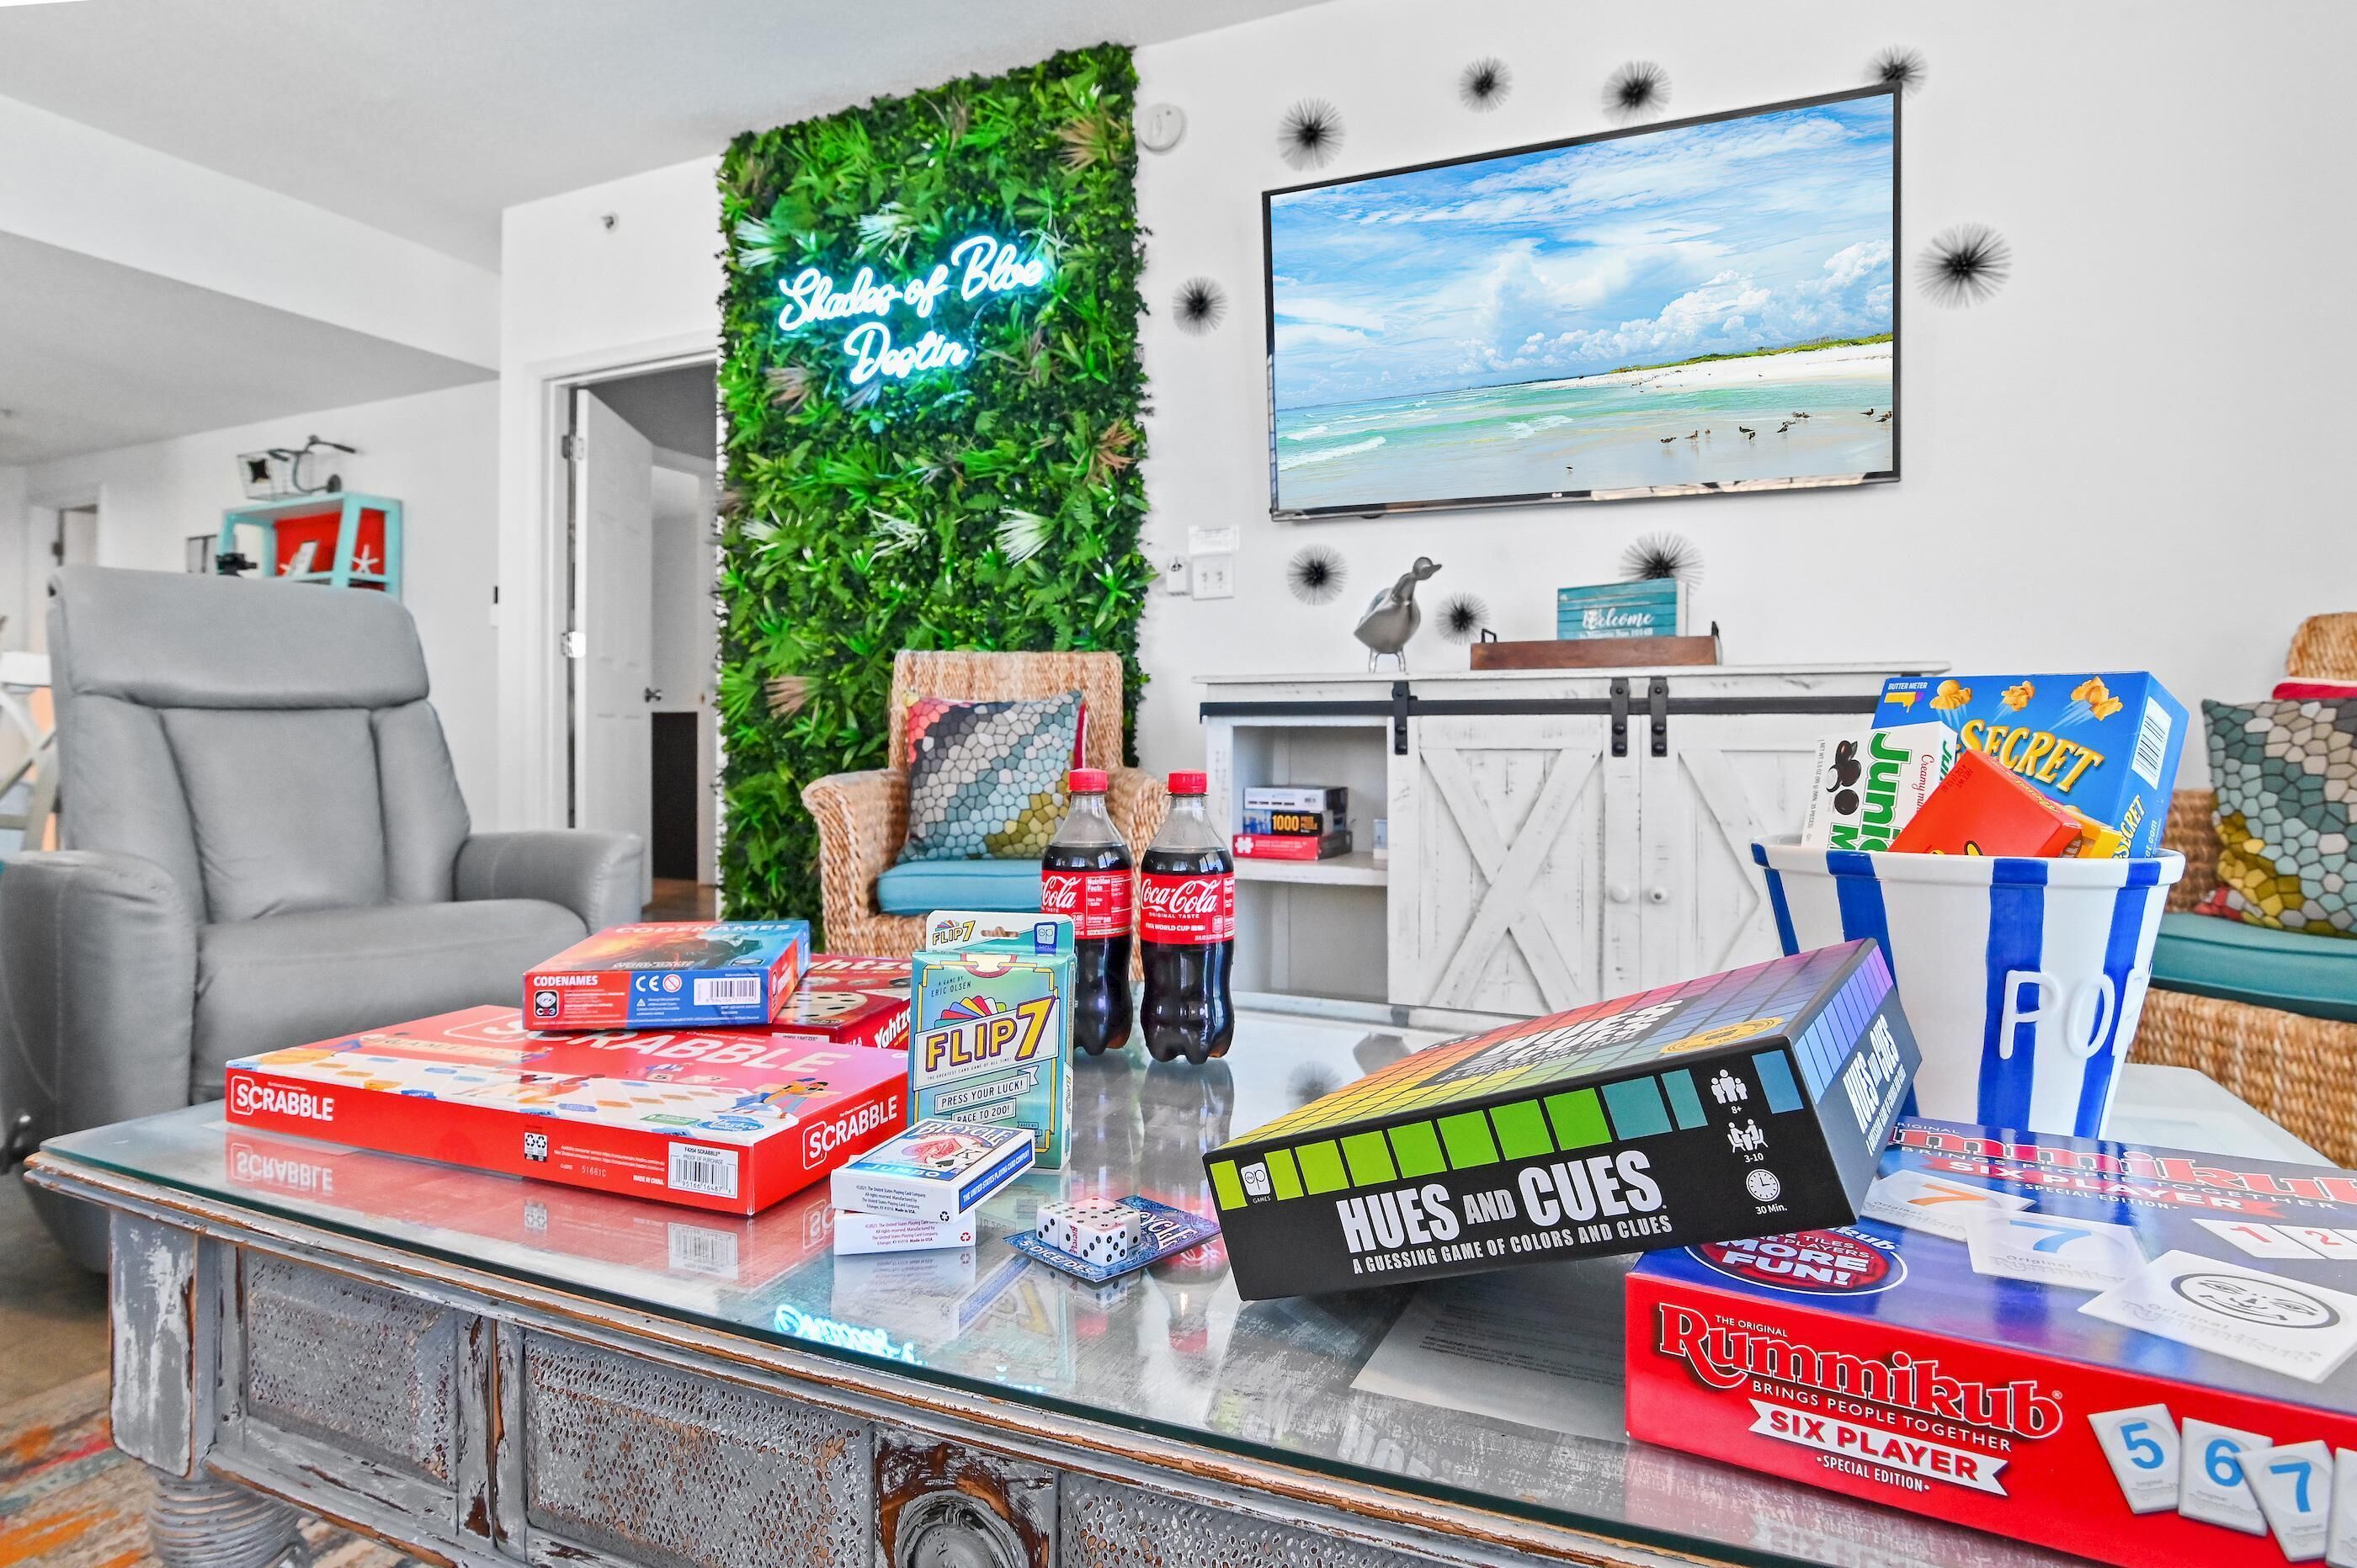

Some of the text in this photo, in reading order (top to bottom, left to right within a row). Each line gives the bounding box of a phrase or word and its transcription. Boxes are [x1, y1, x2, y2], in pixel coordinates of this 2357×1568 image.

[778, 267, 902, 331] Shades
[904, 263, 950, 318] of
[843, 322, 970, 385] Destin
[1582, 608, 1655, 630] Welcome
[1959, 718, 2105, 793] SECRET
[1912, 754, 1934, 795] Creamy
[1272, 815, 1300, 832] 1000
[2114, 794, 2146, 858] SECRET
[1141, 878, 1222, 913] Coca-Cola
[932, 920, 976, 945] FLIP 7
[533, 975, 599, 987] CODENAMES
[931, 981, 971, 997] ERIC OLSEN
[943, 977, 956, 986] GAME
[926, 994, 1056, 1073] FLIP 7
[936, 1071, 957, 1080] GREATEST
[1843, 1051, 1879, 1135] HUES
[1870, 1014, 1900, 1082] CUES
[237, 1083, 334, 1121] SCRABBLE
[941, 1079, 1024, 1108] PRESS YOUR LUCK!
[1731, 1105, 1742, 1114] 8+
[809, 1095, 898, 1159] SCRABBLE
[957, 1105, 1010, 1124] RACE TO 200!
[1896, 1122, 1960, 1134] RIGINAL
[916, 1122, 1014, 1148] BICYCLE
[865, 1163, 940, 1177] JUMBO
[1743, 1152, 1764, 1162] 3-10
[962, 1149, 1030, 1203] THE UNITED STATES PLAYING CARD COMPANY
[1901, 1145, 2338, 1211] BRINGS PEOPLE TOGETHER
[1948, 1161, 2244, 1211] SIX PLAYER
[1253, 1195, 1271, 1204] GAMES
[1755, 1203, 1788, 1215] 30 Min.
[1906, 1183, 1990, 1207] 7
[1139, 1211, 1198, 1252] CYCLE
[1337, 1183, 1460, 1253] HUES
[1462, 1188, 1517, 1225] AND
[1353, 1215, 1673, 1274] A GUESSING GAME OF COLORS AND CLUES
[1783, 1239, 1875, 1260] PLAYERS.
[1802, 1234, 1860, 1251] TILES.
[2009, 1219, 2093, 1253] 7
[2229, 1226, 2344, 1246] 1 2
[1715, 1238, 1870, 1273] MORE
[1721, 1250, 1852, 1286] FUN!
[1715, 1315, 1788, 1337] THE ORIGINAL
[1753, 1380, 2013, 1453] BRINGS PEOPLE TOGETHER
[1769, 1409, 1979, 1482] SIX PLAYER
[2119, 1422, 2312, 1512] 5 6 7
